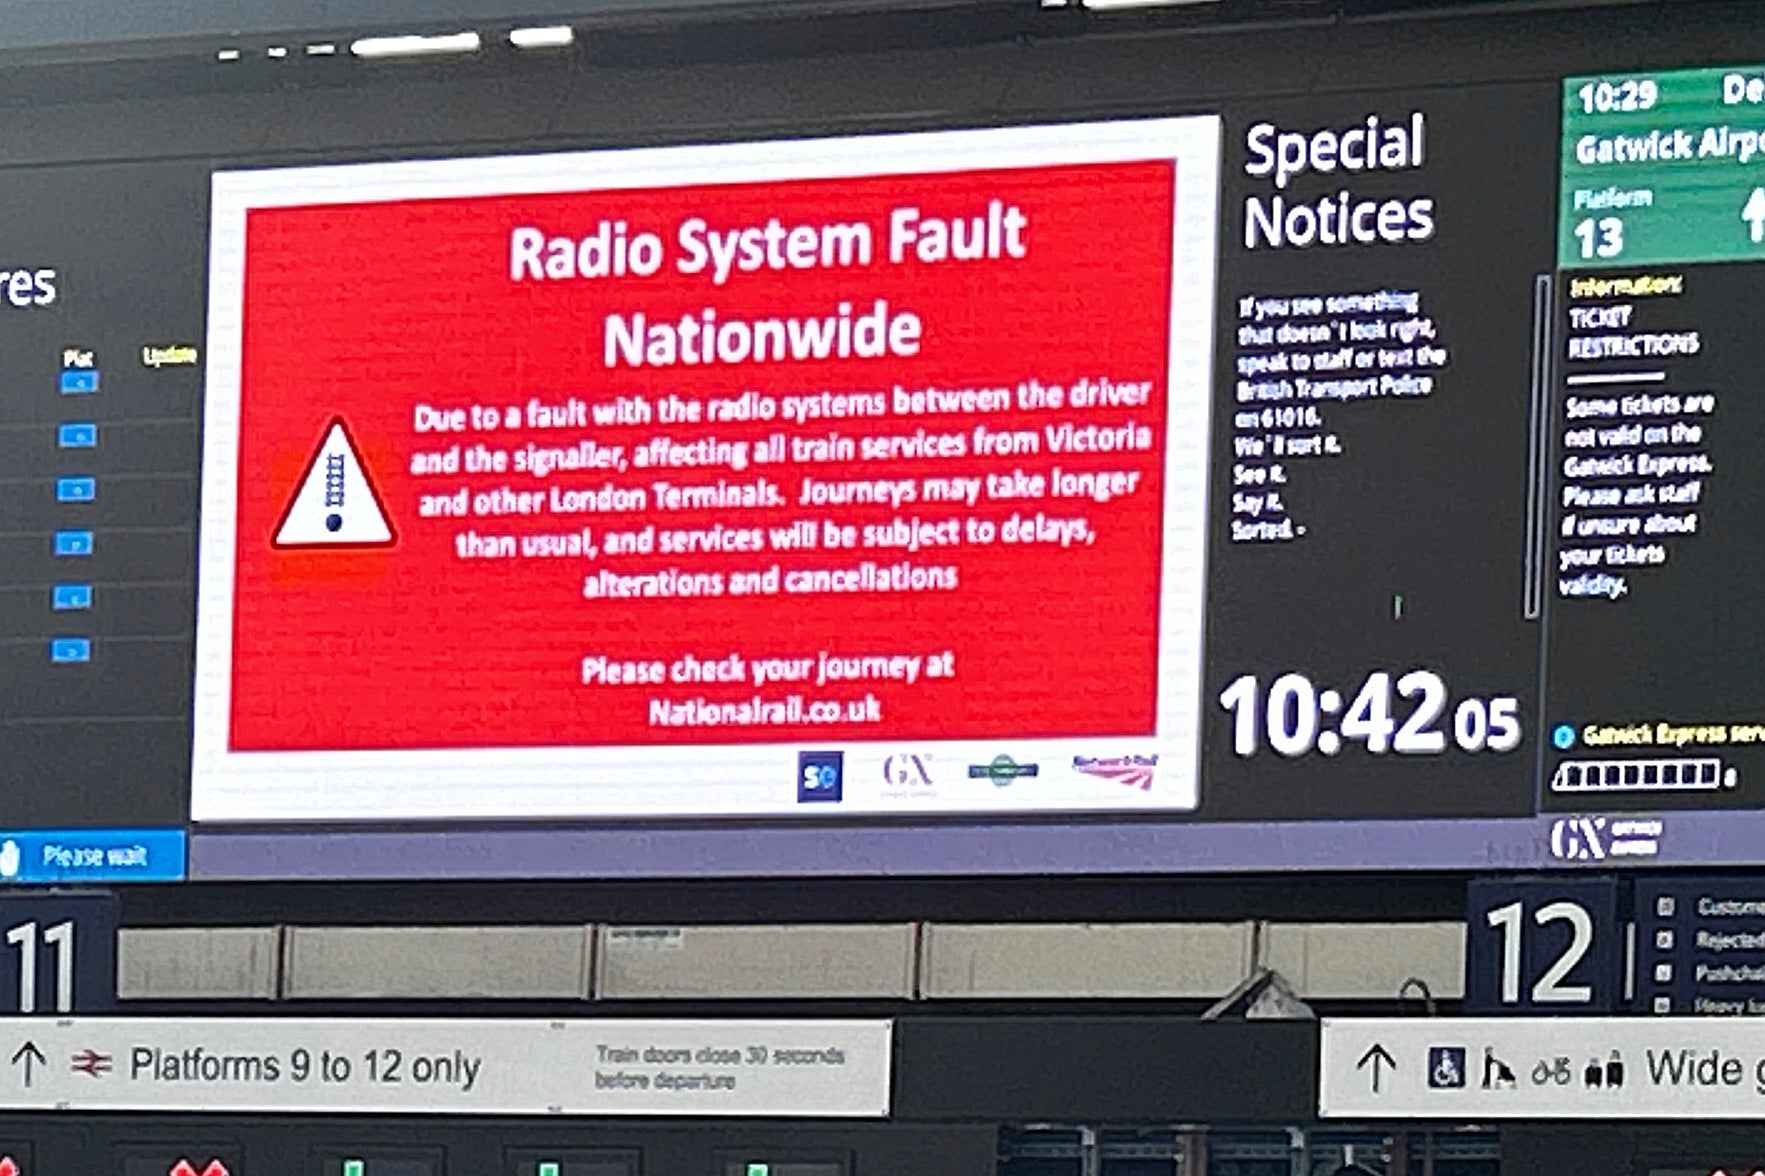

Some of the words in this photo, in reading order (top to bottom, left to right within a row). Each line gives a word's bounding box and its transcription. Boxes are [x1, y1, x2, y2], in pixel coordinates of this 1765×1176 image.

[1579, 80, 1657, 113] 10:29
[1245, 112, 1424, 188] Special
[1576, 129, 1692, 164] Gatwick
[510, 220, 664, 282] Radio
[676, 217, 872, 285] System
[889, 199, 1028, 264] Fault
[1245, 190, 1436, 248] Notices
[1574, 217, 1623, 258] 13
[604, 299, 922, 368] Nationwide
[413, 402, 466, 432] Due
[471, 403, 500, 430] to
[504, 405, 521, 429] a
[527, 397, 587, 427] fault
[592, 395, 650, 425] with
[658, 393, 700, 424] the
[707, 391, 776, 421] radio
[781, 390, 885, 424] systems
[892, 384, 1010, 414] between
[1018, 379, 1064, 410] the
[1070, 376, 1152, 407] driver
[410, 445, 459, 474] and
[465, 443, 507, 472] the
[514, 440, 628, 477] signaller,
[633, 436, 749, 471] affecting
[754, 433, 786, 463] all
[792, 432, 855, 463] train
[861, 428, 967, 460] services
[972, 424, 1039, 455] from
[1046, 420, 1152, 452] Victoria
[419, 487, 467, 517] and
[474, 487, 546, 514] other
[550, 483, 647, 513] London
[652, 478, 787, 510] Terminals.
[799, 477, 917, 508] Journeys
[922, 476, 980, 507] may
[986, 469, 1046, 499] take
[1051, 467, 1142, 503] longer
[456, 531, 517, 559] than
[521, 526, 598, 561] usual,
[604, 525, 654, 555] and
[659, 524, 764, 554] services
[769, 520, 818, 550] will
[823, 520, 857, 548] be
[863, 517, 960, 551] subject
[967, 516, 996, 544] to
[1001, 512, 1096, 547] delays,
[583, 567, 724, 600] alterations
[728, 564, 782, 596] and
[784, 561, 960, 593] cancellations
[582, 655, 664, 686] Please
[671, 654, 746, 683] check
[752, 657, 812, 689] your
[817, 651, 920, 687] journey
[926, 651, 956, 678] at
[649, 693, 881, 729] Nationalrail.co.uk
[1219, 670, 1448, 756] 10:42
[1454, 697, 1522, 752] 05
[43, 845, 103, 868] Please
[106, 845, 148, 868] wait
[5, 921, 75, 1013] 11
[1486, 901, 1593, 1003] 12
[130, 1046, 281, 1083] Platforms
[290, 1049, 310, 1083] 9
[320, 1052, 352, 1083] to
[364, 1049, 402, 1083] 12
[413, 1050, 481, 1092] only
[596, 1044, 639, 1065] Train
[644, 1045, 691, 1066] doors
[695, 1045, 741, 1066] close
[744, 1045, 768, 1066] 30
[772, 1046, 845, 1066] seconds
[1646, 1049, 1743, 1085] Wide
[595, 1071, 650, 1090] before
[654, 1071, 736, 1093] departure
